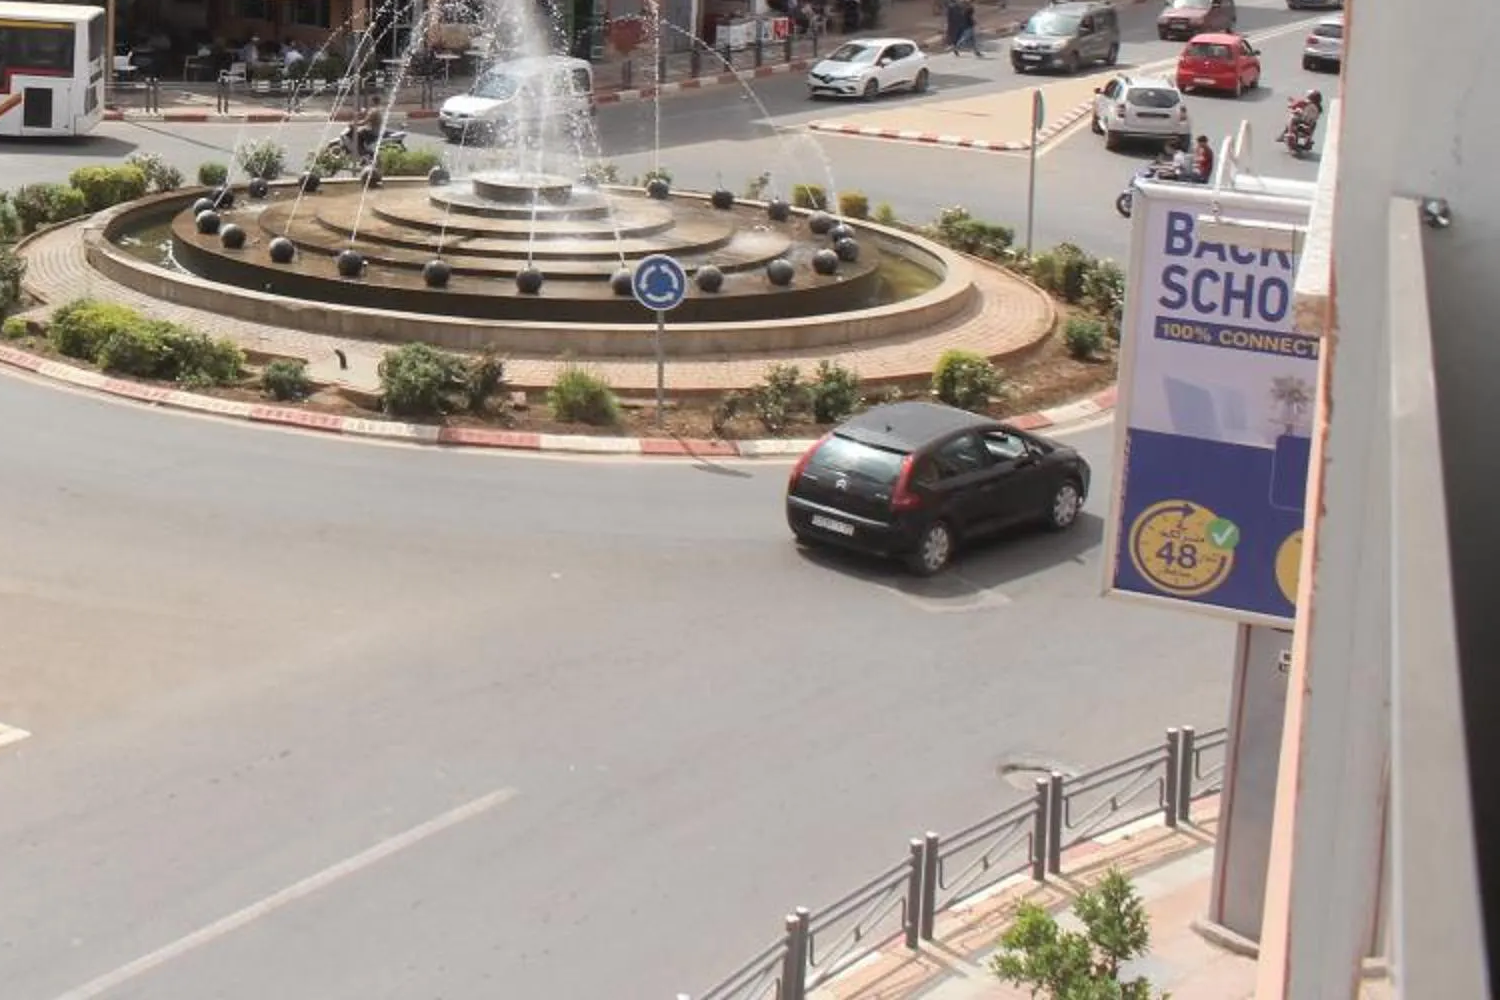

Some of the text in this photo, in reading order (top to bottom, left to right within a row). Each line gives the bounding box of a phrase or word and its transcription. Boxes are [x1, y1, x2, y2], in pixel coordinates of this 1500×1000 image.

[1158, 263, 1290, 323] SCHO
[1161, 322, 1212, 343] 100%
[1155, 540, 1197, 570] 48
